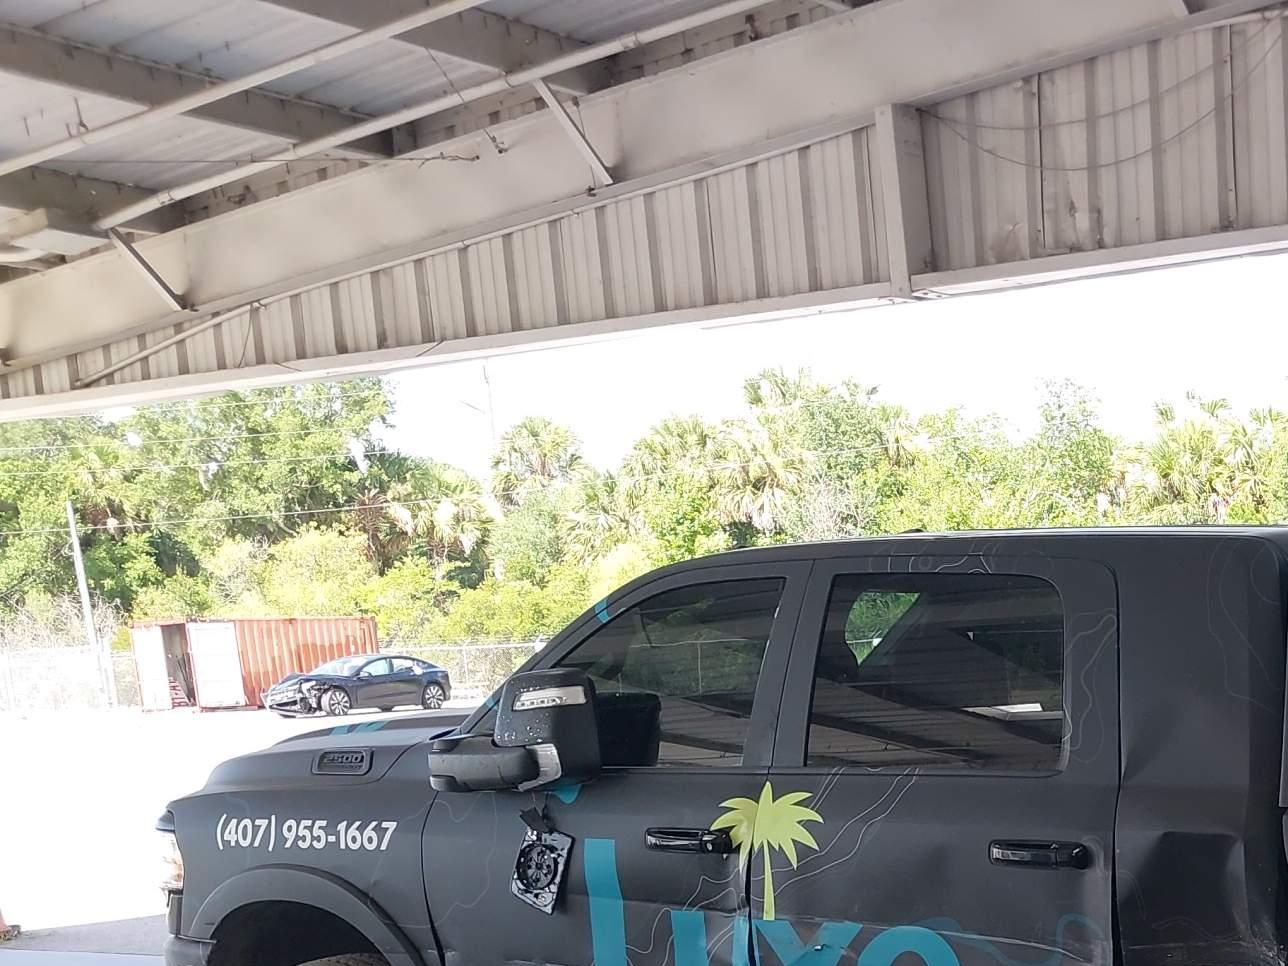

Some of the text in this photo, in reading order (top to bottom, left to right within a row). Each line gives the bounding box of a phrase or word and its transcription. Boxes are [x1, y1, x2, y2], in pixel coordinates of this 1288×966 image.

[323, 753, 362, 763] 2500
[216, 813, 398, 852] (407) 955-1667
